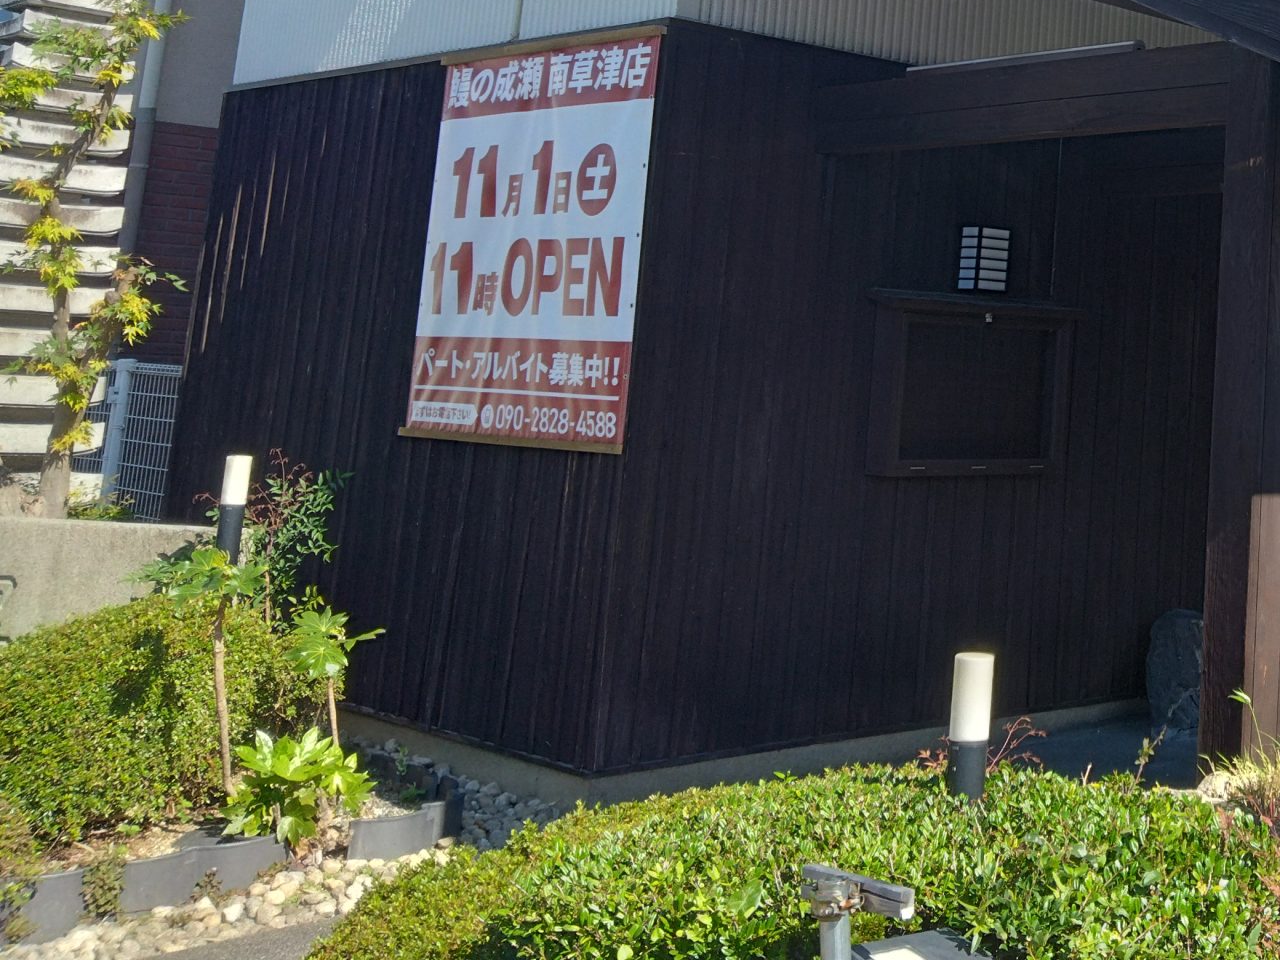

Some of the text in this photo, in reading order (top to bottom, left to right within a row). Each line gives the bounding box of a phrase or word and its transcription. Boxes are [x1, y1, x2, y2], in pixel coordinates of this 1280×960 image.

[448, 43, 652, 109] 鰻の成瀬 南草津店
[495, 404, 617, 439] 090-2828-4588
